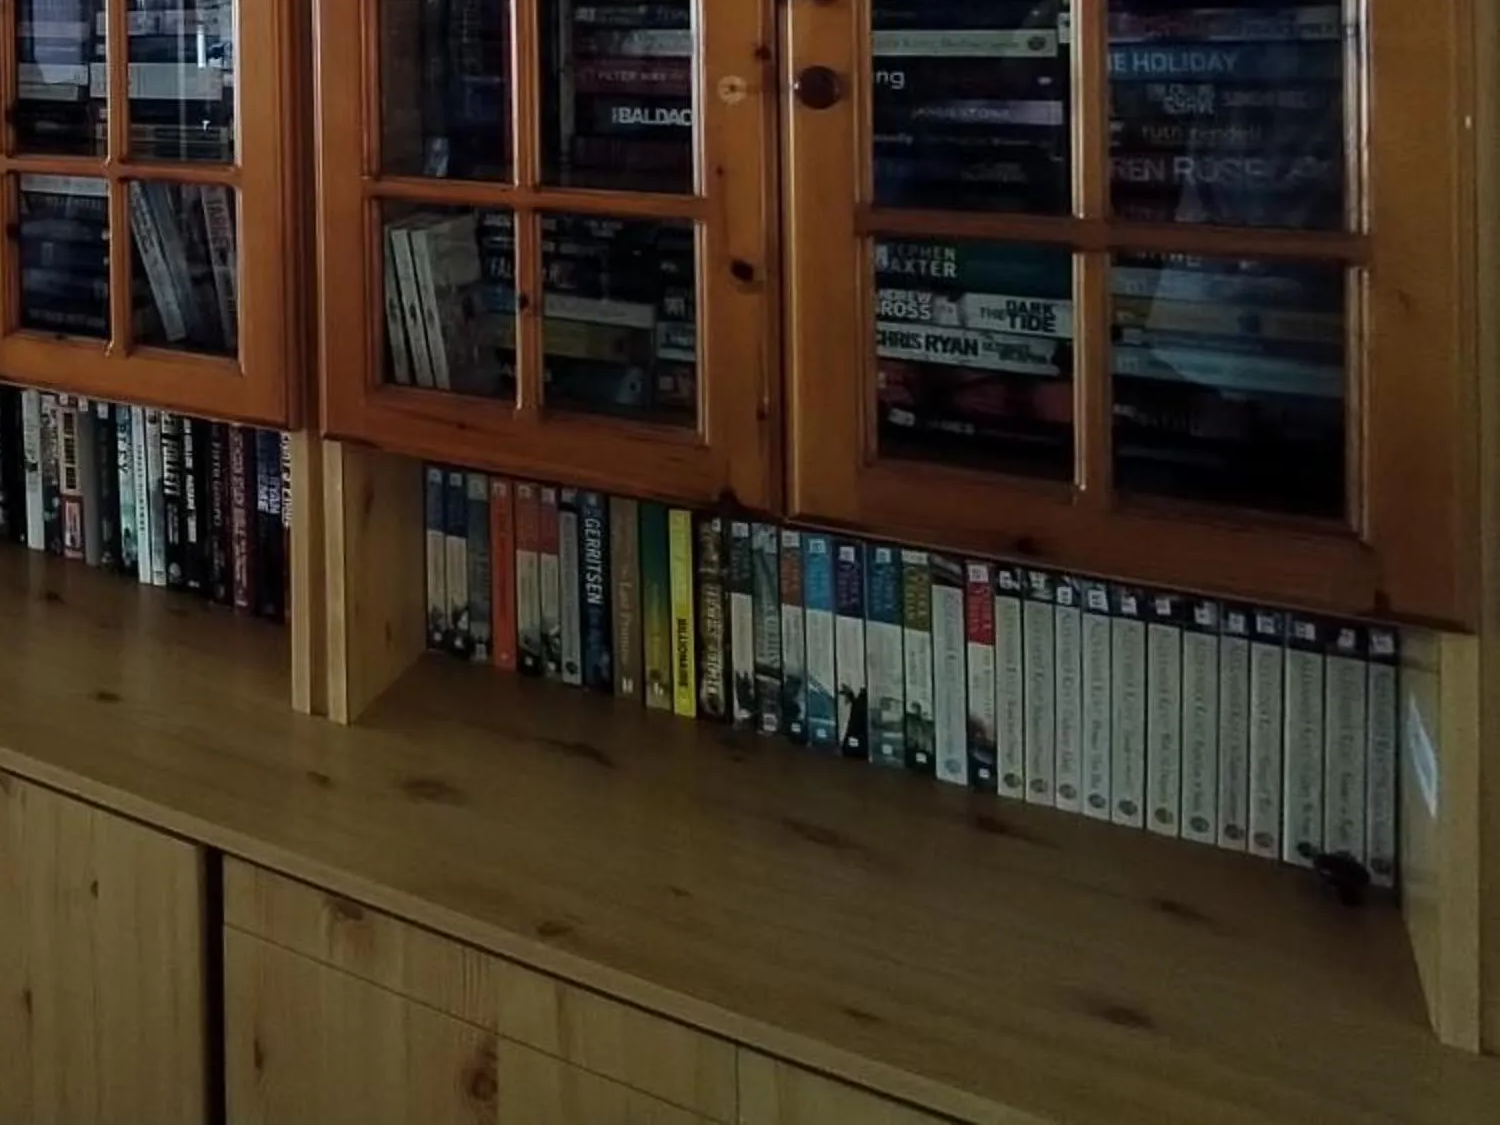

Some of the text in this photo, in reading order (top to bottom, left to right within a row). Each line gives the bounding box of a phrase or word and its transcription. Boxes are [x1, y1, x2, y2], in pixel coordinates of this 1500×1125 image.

[1131, 49, 1238, 73] HOLIDAY
[1172, 154, 1269, 183] ROSE
[1005, 299, 1057, 318] DARK
[1007, 314, 1057, 334] TIDE
[924, 334, 980, 357] RYAN
[583, 517, 604, 605] GERRITSEN
